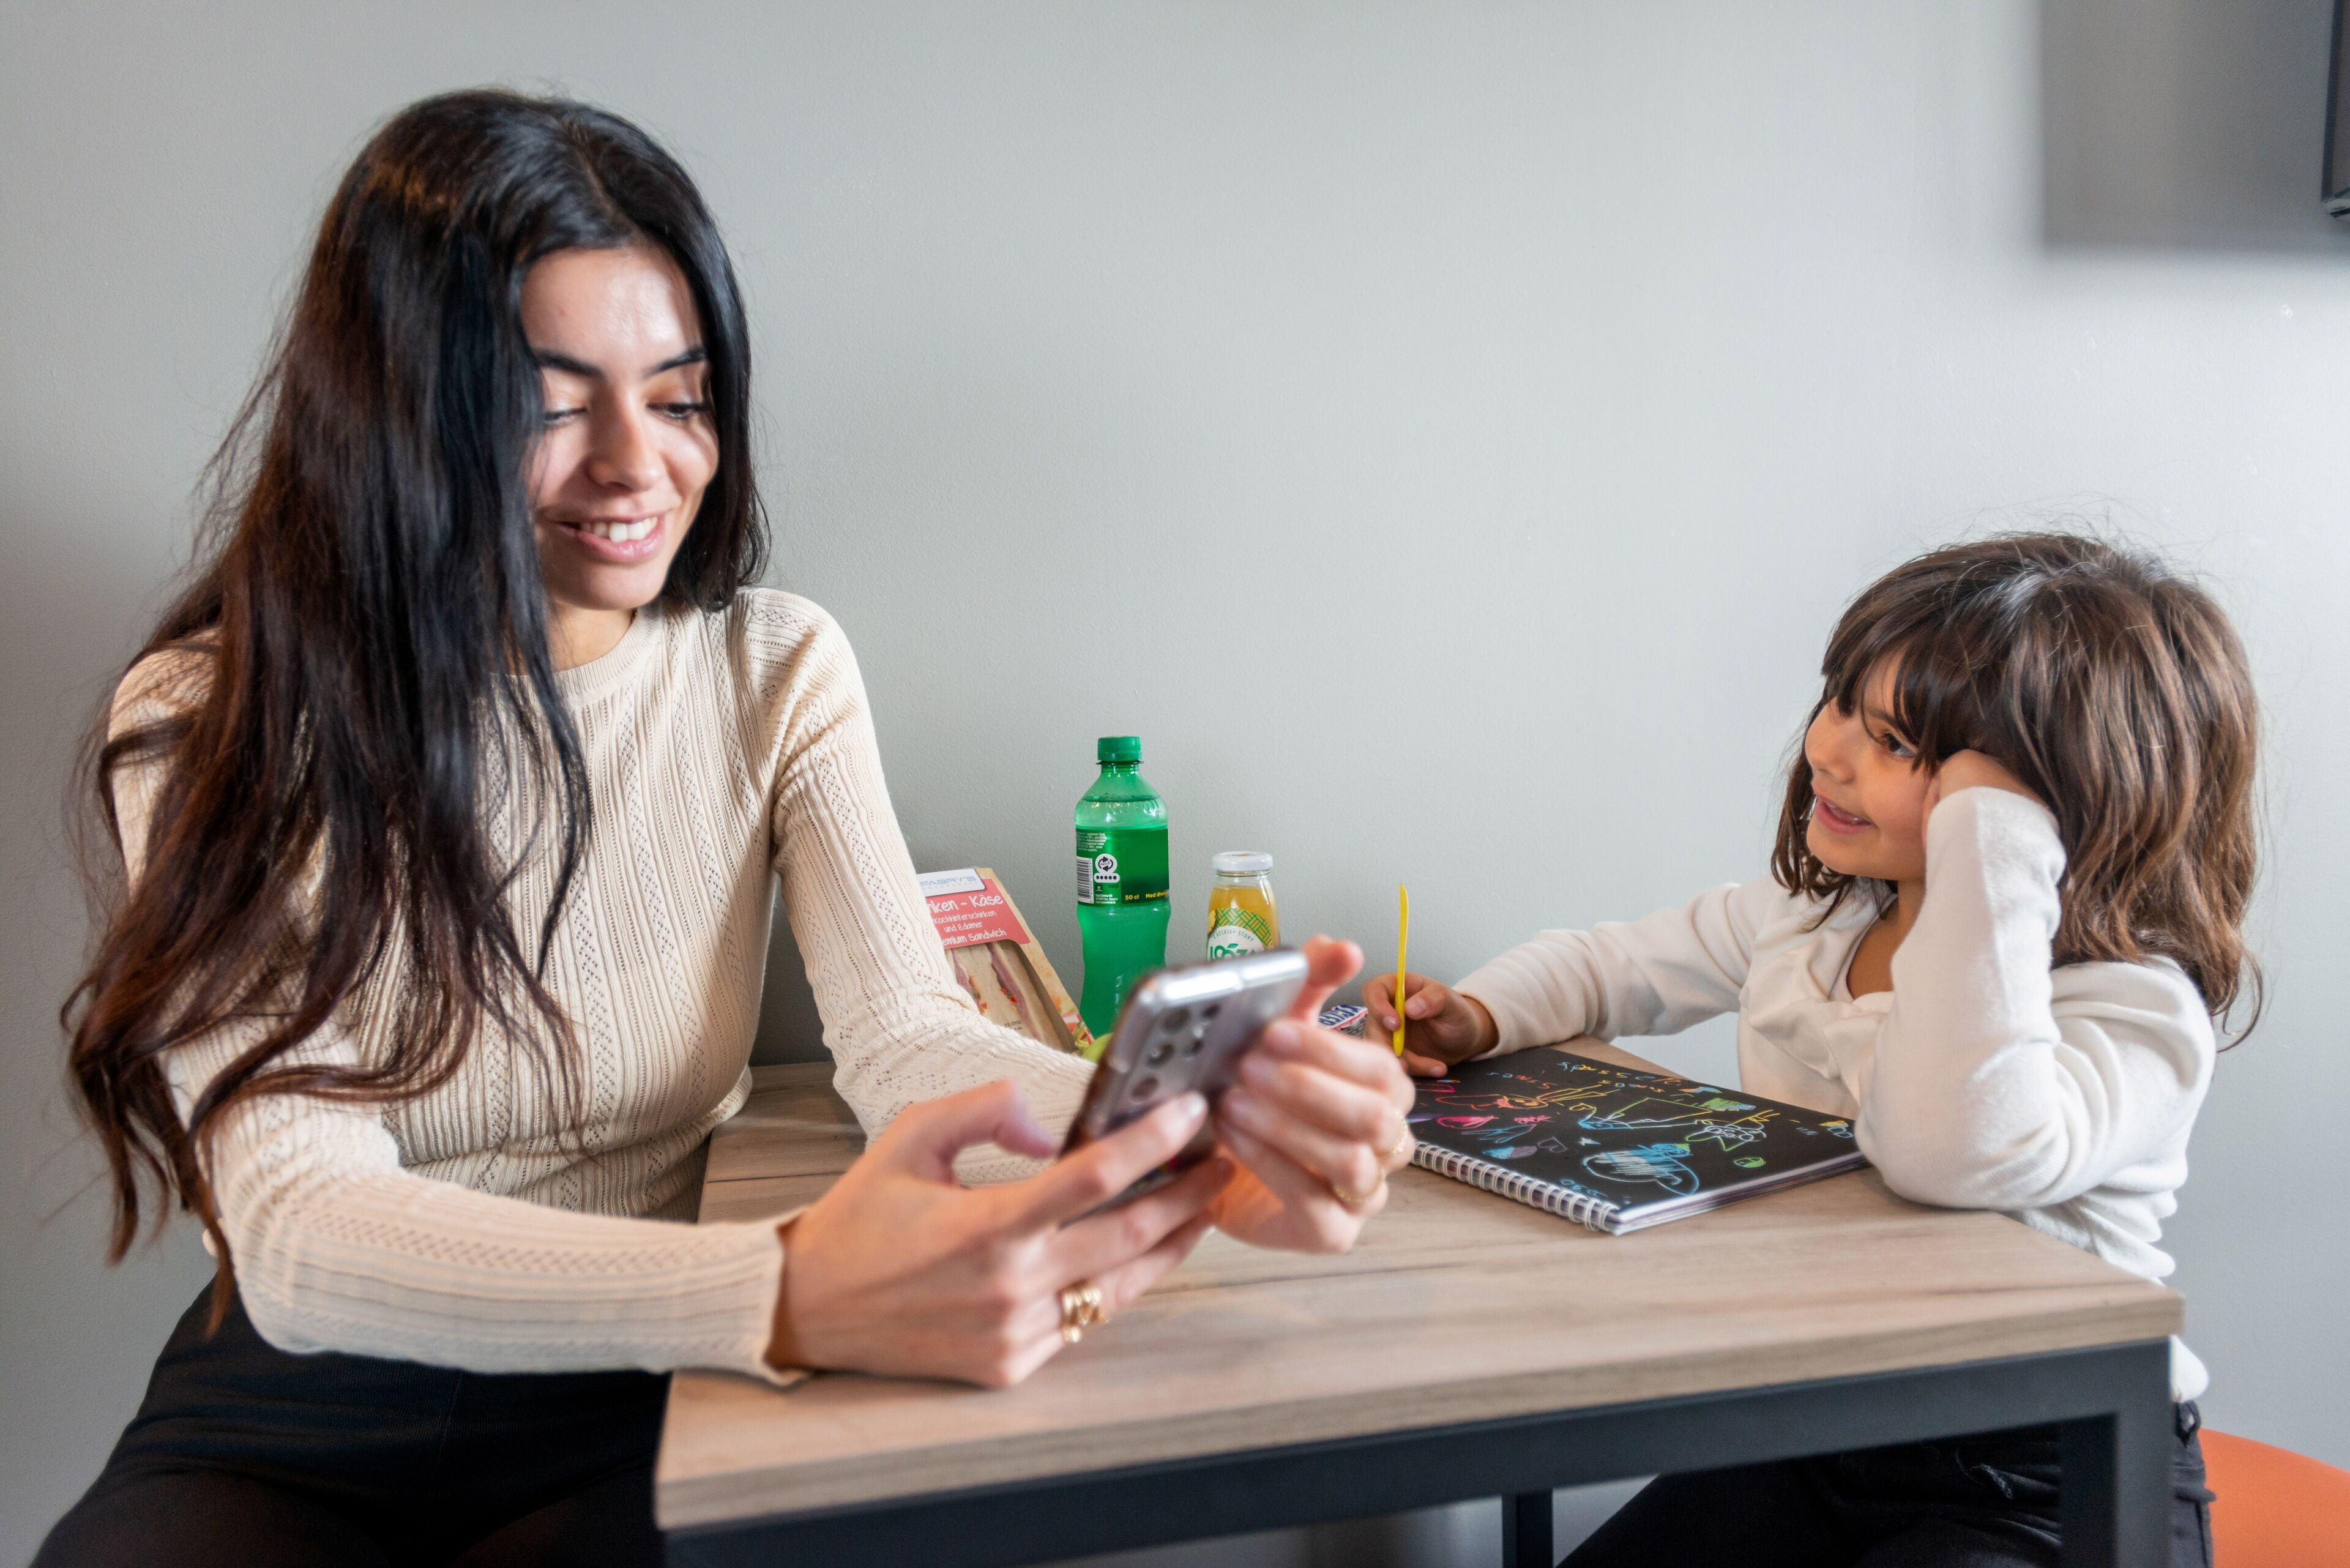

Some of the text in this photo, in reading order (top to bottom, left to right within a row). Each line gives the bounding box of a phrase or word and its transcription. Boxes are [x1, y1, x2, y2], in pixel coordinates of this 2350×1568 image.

[969, 894, 1003, 908] Käse
[943, 921, 983, 933] und Edamer
[969, 928, 1007, 942] Sandwich
[1238, 931, 1254, 941] STORY
